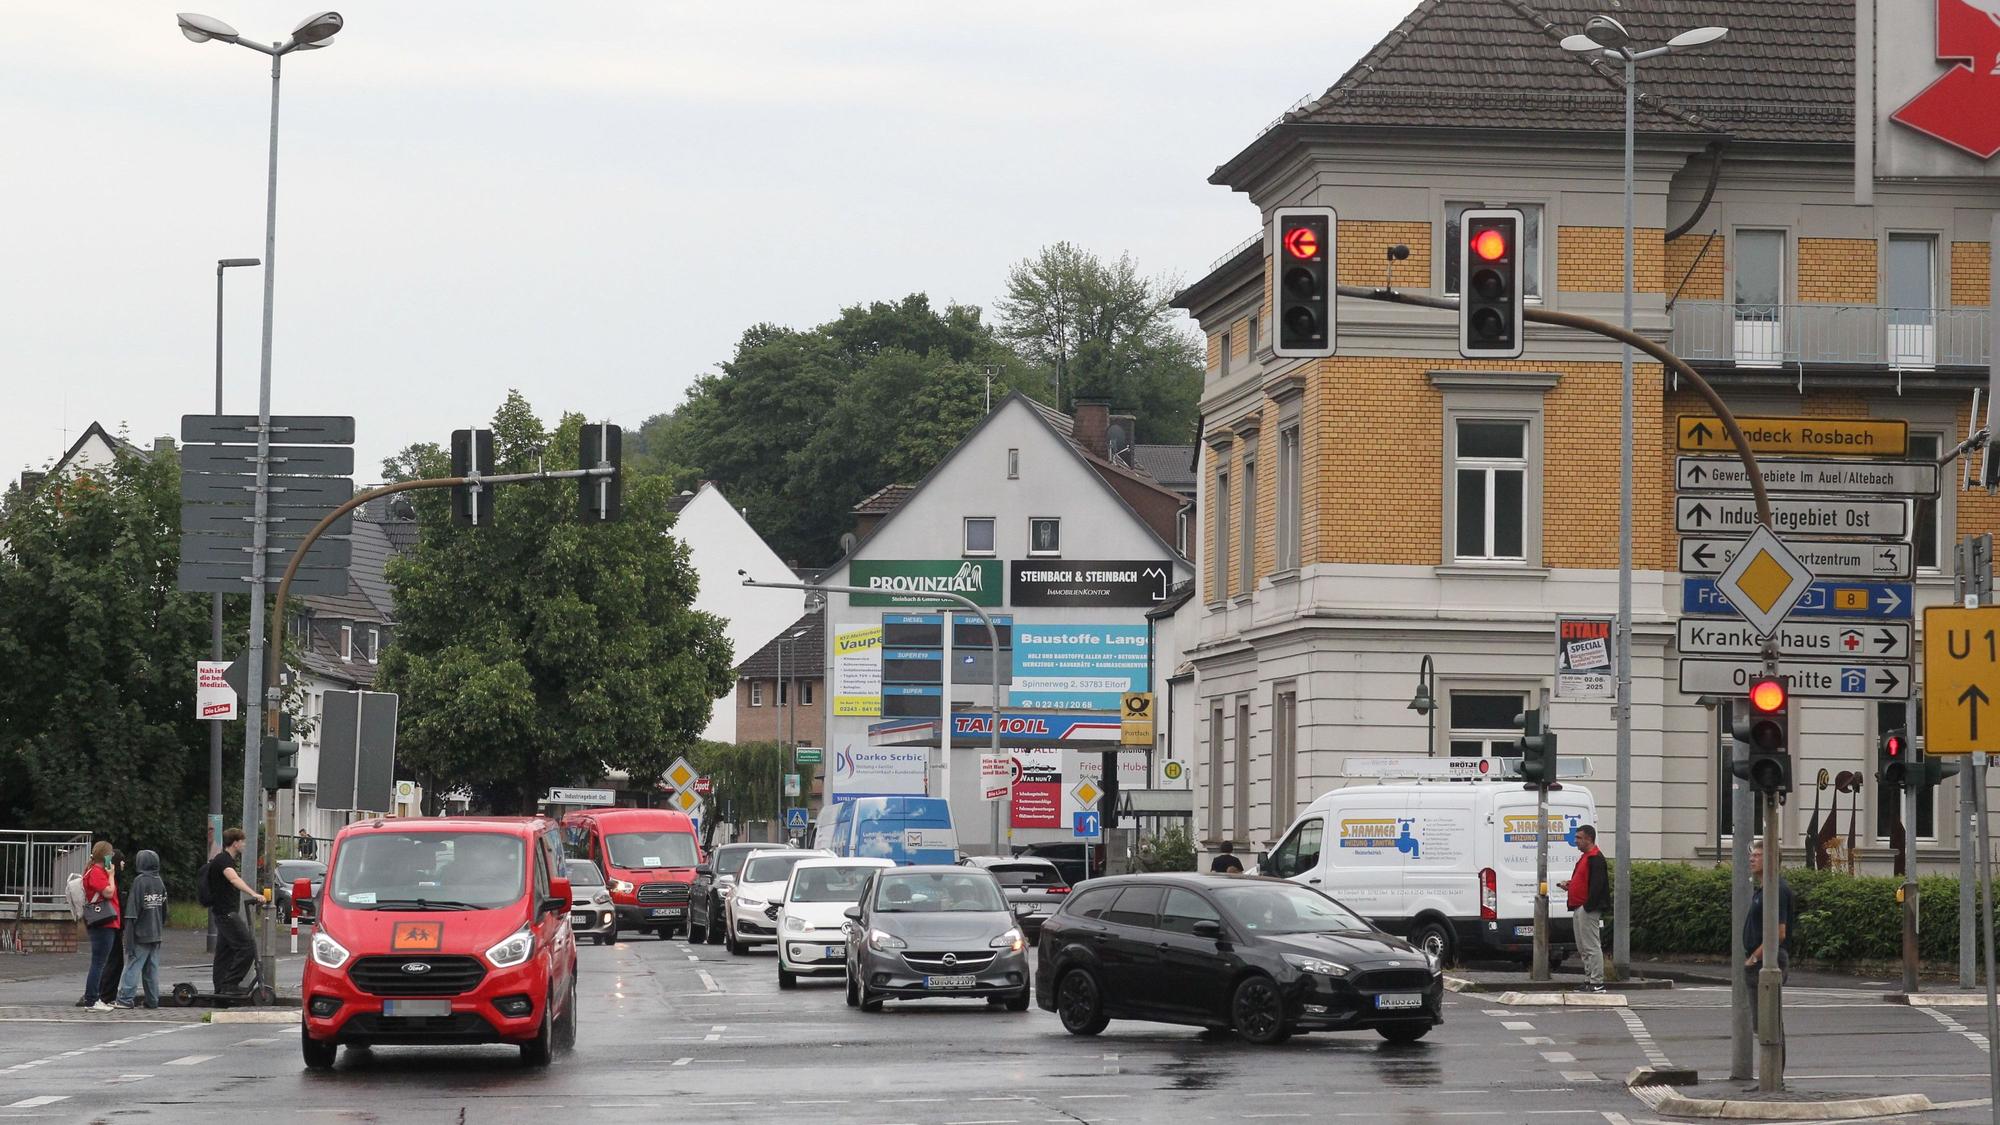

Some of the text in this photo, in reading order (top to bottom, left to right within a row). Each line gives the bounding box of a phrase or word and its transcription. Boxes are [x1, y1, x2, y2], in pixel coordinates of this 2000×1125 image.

[1802, 428, 1874, 445] Rosbach
[1800, 470, 1813, 483] Im
[1845, 508, 1870, 527] Ost
[1020, 570, 1137, 583] STEINBACH & STEINBACH
[870, 576, 977, 592] PROVINZIAL
[1803, 593, 1812, 605] 3
[1847, 592, 1855, 606] 8
[1021, 633, 1100, 645] Baustoffe
[1691, 627, 1831, 649] Krankehaus
[1570, 640, 1602, 654] SPECIAL
[1022, 680, 1069, 690] Spinnerweg
[1079, 680, 1103, 688] 53783
[1105, 680, 1127, 688] Eitorf
[214, 705, 229, 713] Linke
[956, 717, 1049, 734] TAMOIL
[856, 753, 887, 761] Darko
[1449, 760, 1478, 769] BRÖTJE
[564, 792, 598, 801] Industriegebiet
[1504, 855, 1529, 863] WÄRME
[407, 963, 425, 972] Ford
